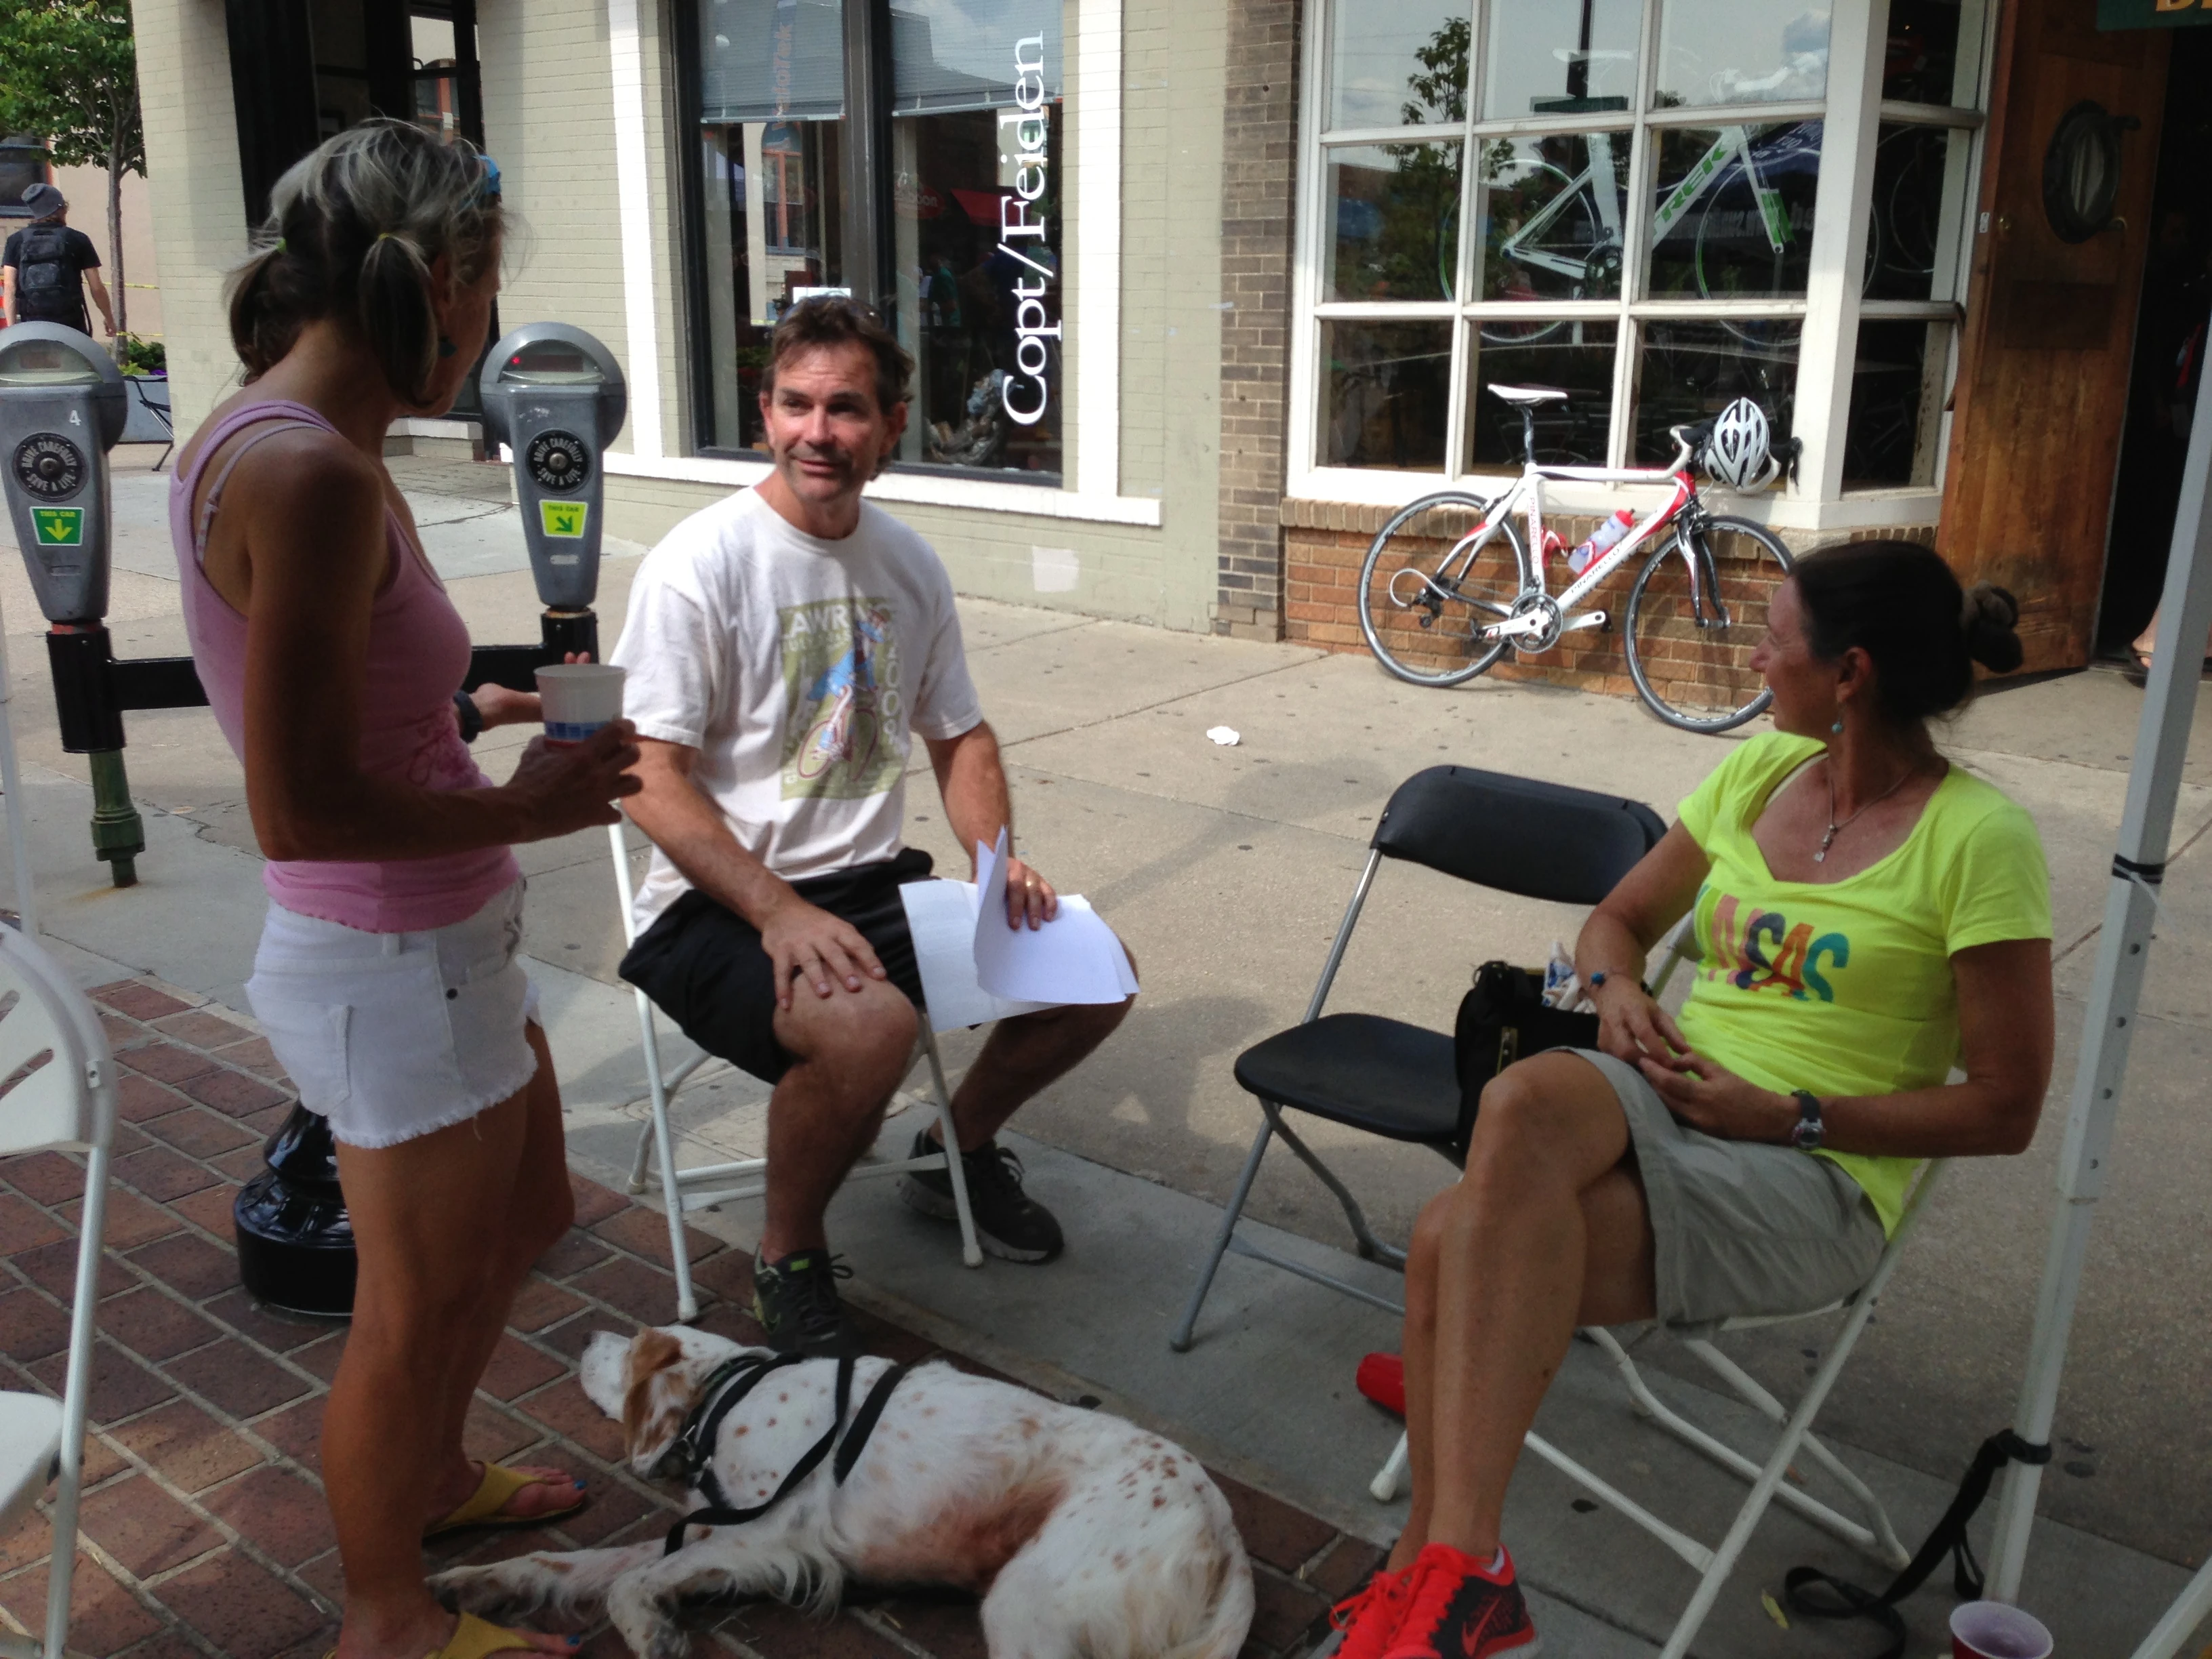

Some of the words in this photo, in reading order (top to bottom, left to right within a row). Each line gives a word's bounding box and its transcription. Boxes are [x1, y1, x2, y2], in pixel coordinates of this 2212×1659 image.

[1654, 142, 1727, 235] REK
[997, 30, 1062, 425] Copt/Feiden
[68, 409, 81, 426] 4
[1529, 497, 1539, 565] PINARELLO
[1570, 548, 1620, 594] PINARELLO
